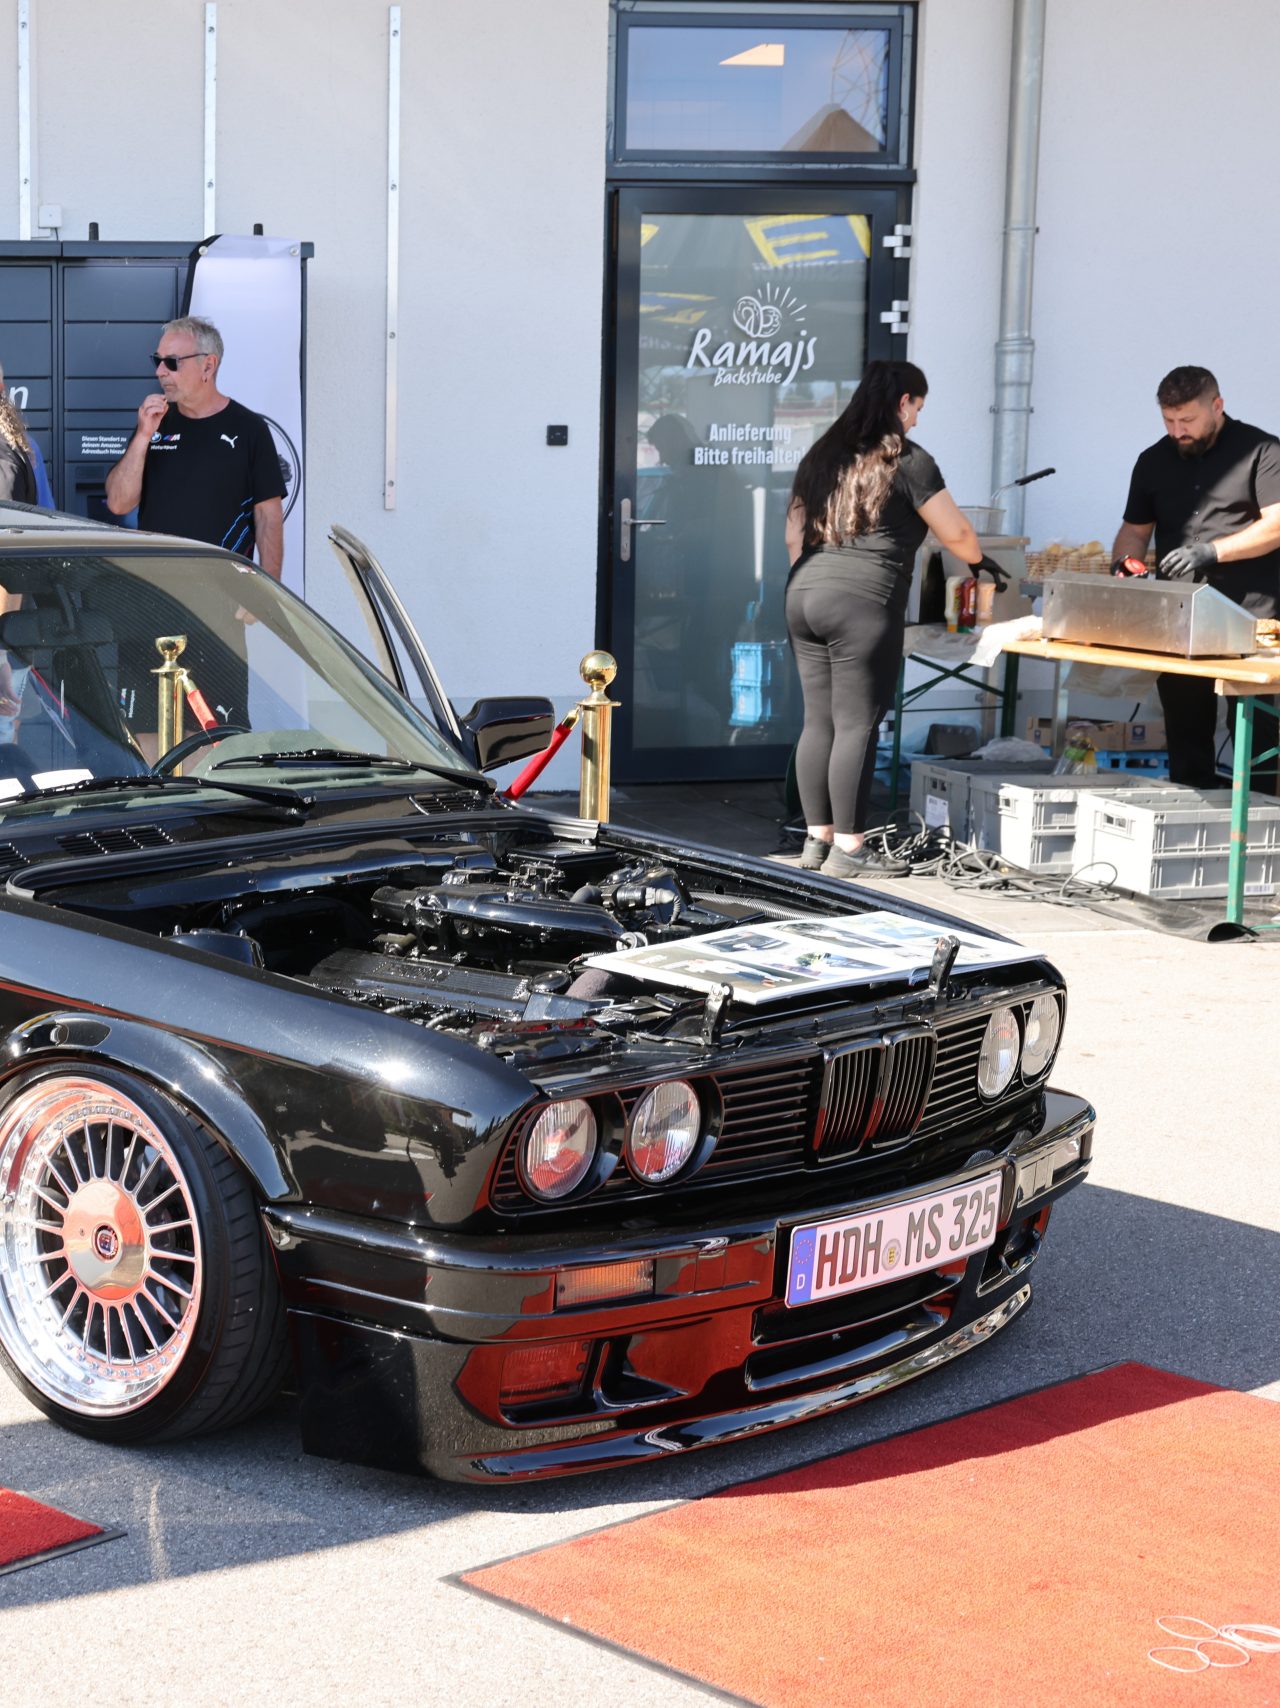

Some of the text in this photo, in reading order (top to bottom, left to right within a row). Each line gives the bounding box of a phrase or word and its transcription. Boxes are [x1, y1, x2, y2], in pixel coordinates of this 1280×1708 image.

[686, 328, 818, 387] Ramajs
[713, 366, 783, 387] Backstube
[709, 423, 792, 443] Anlieferung
[694, 446, 729, 465] Bitte
[815, 1184, 997, 1290] HDH MS 325
[797, 1274, 806, 1290] D
